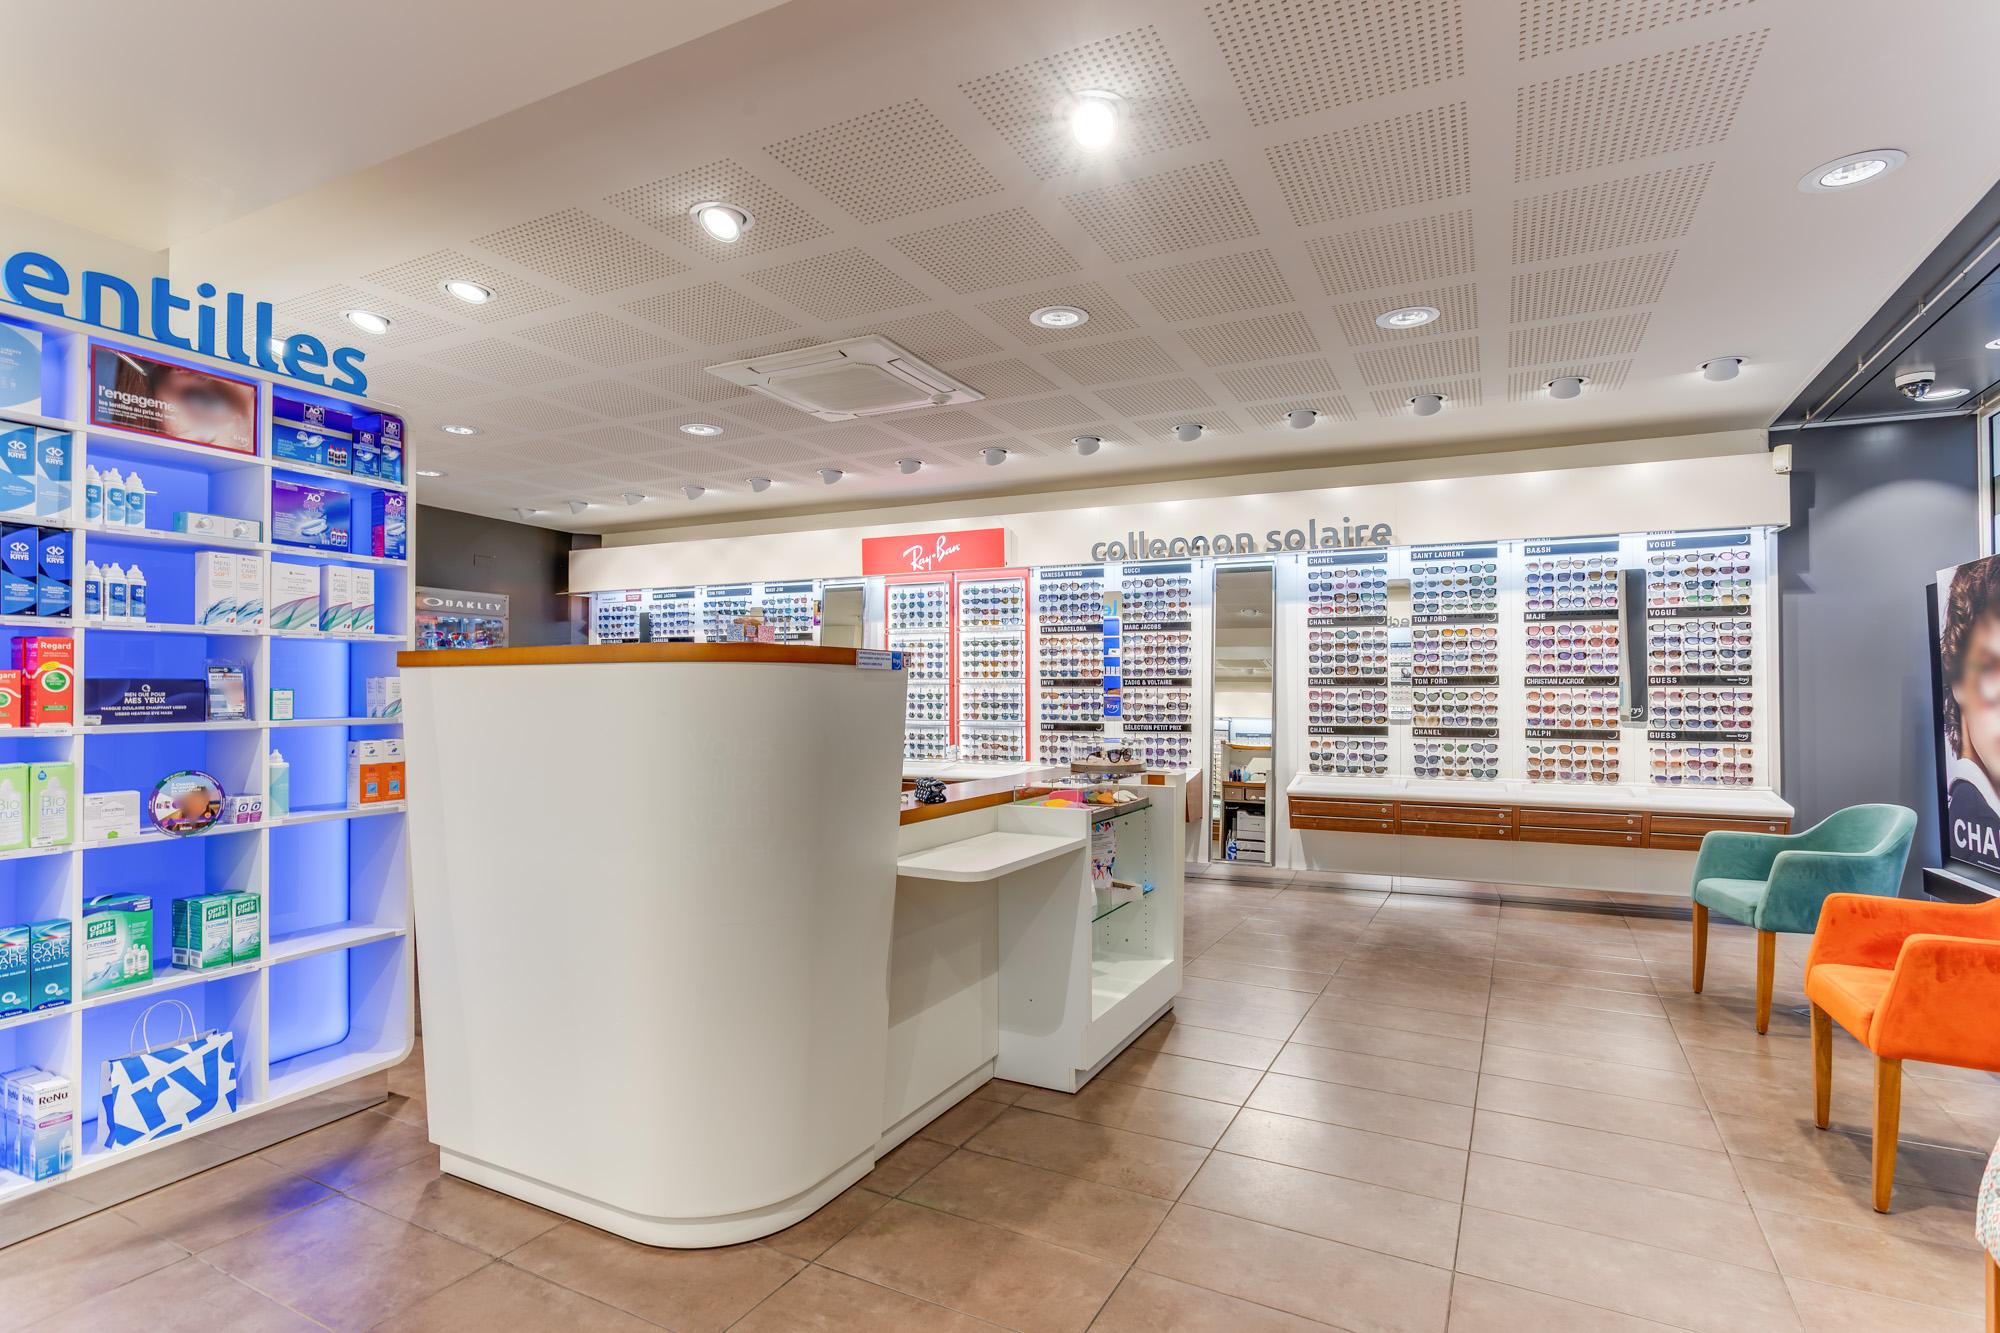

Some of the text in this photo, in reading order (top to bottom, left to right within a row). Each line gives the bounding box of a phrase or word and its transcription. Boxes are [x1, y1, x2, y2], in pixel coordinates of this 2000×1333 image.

[1, 252, 368, 398] entilles
[1649, 540, 1677, 549] VOGUE
[1526, 546, 1551, 554] BA&SH
[10, 553, 29, 561] KRYS
[1413, 550, 1465, 560] SAINT LAURENT
[46, 557, 64, 565] KRYS
[1526, 612, 1546, 620] MAJE
[1649, 608, 1677, 617] VOGUE
[1309, 618, 1335, 626] CHANEL
[1429, 615, 1447, 623] FORD
[40, 641, 72, 650] Regard
[1309, 678, 1335, 686] CHANEL
[1430, 677, 1448, 685] FORD
[1526, 677, 1585, 685] CHRISTIAN LACROIX
[1650, 676, 1677, 684] GUESS
[1309, 726, 1335, 734] CHANEL
[1414, 728, 1442, 736] CHANEL
[1649, 731, 1676, 739] GUESS
[1954, 819, 2000, 859] CHA
[33, 939, 69, 951] SOLO
[38, 1092, 69, 1106] ReNu
